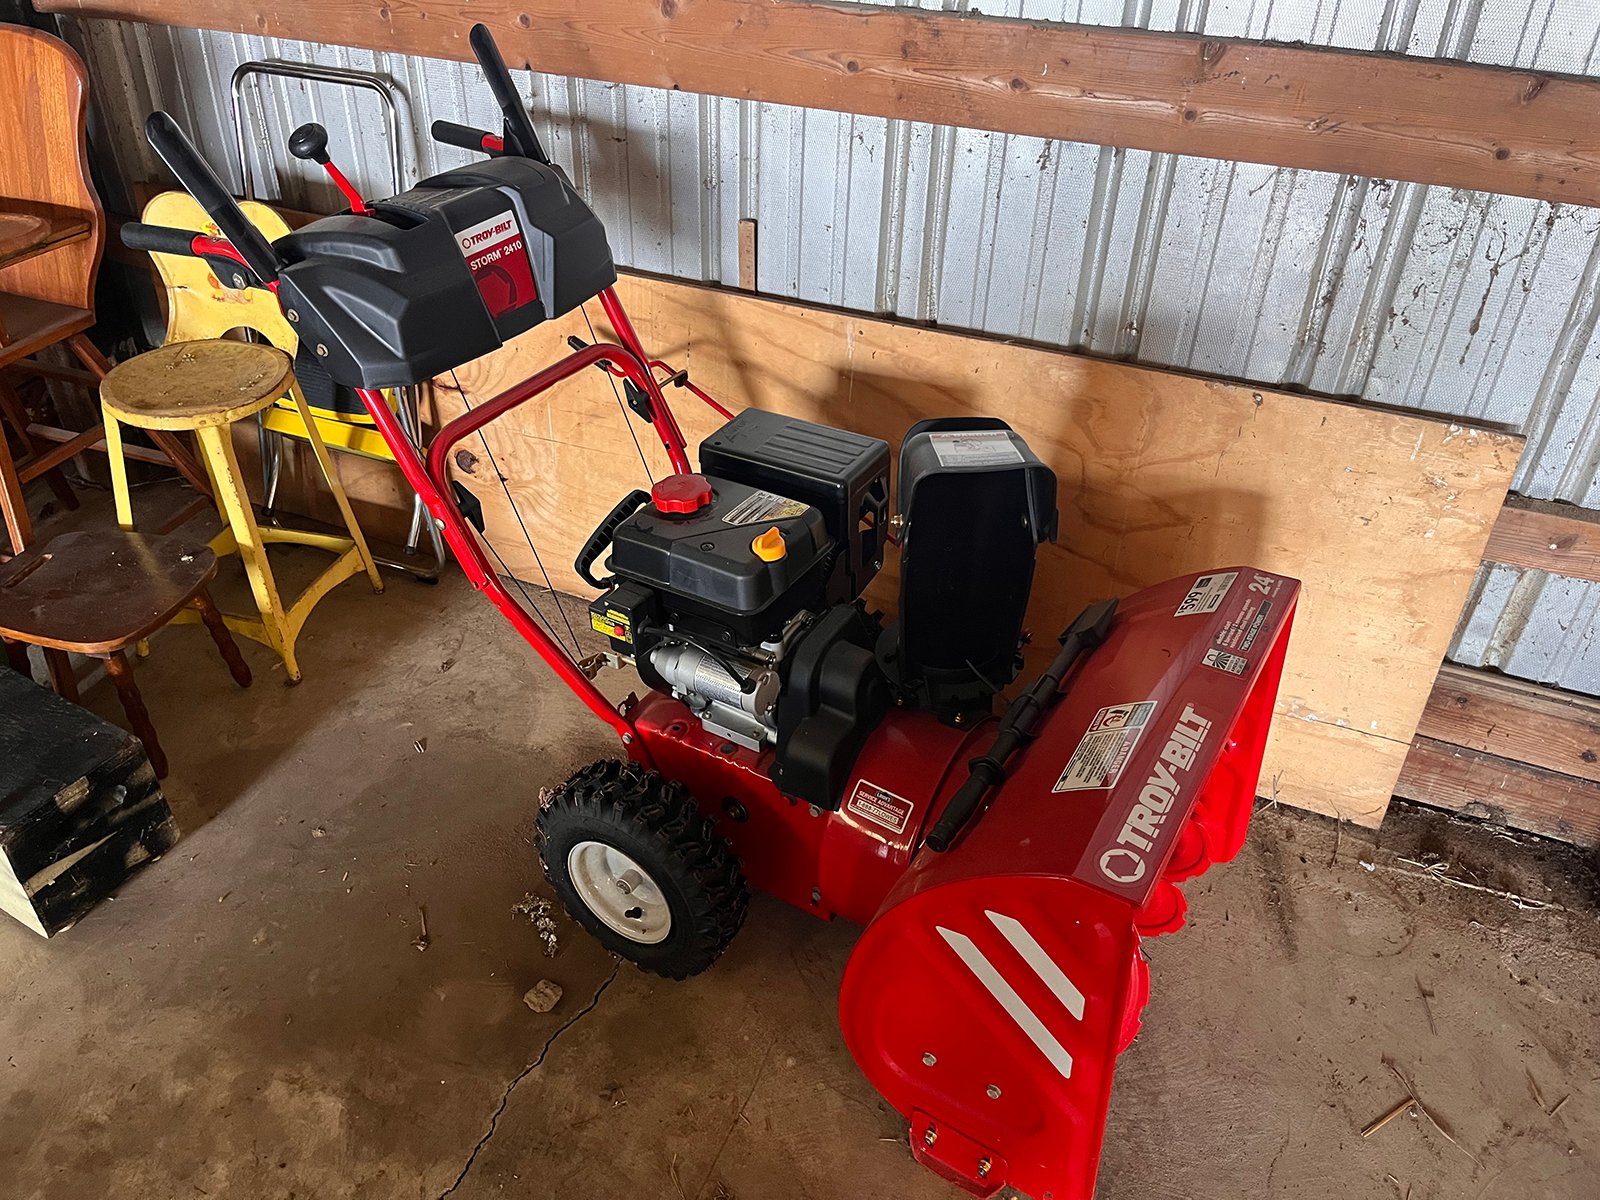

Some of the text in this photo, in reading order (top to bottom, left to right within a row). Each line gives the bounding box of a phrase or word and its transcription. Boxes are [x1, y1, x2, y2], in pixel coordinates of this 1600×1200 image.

[470, 219, 513, 246] TROY-BILT
[470, 240, 523, 270] STORM 2410
[1252, 614, 1265, 628] POWER
[1108, 745, 1129, 774] DANGER
[1116, 704, 1212, 853] TROY-BILT
[858, 790, 905, 815] SERVICE ADVANTAGE
